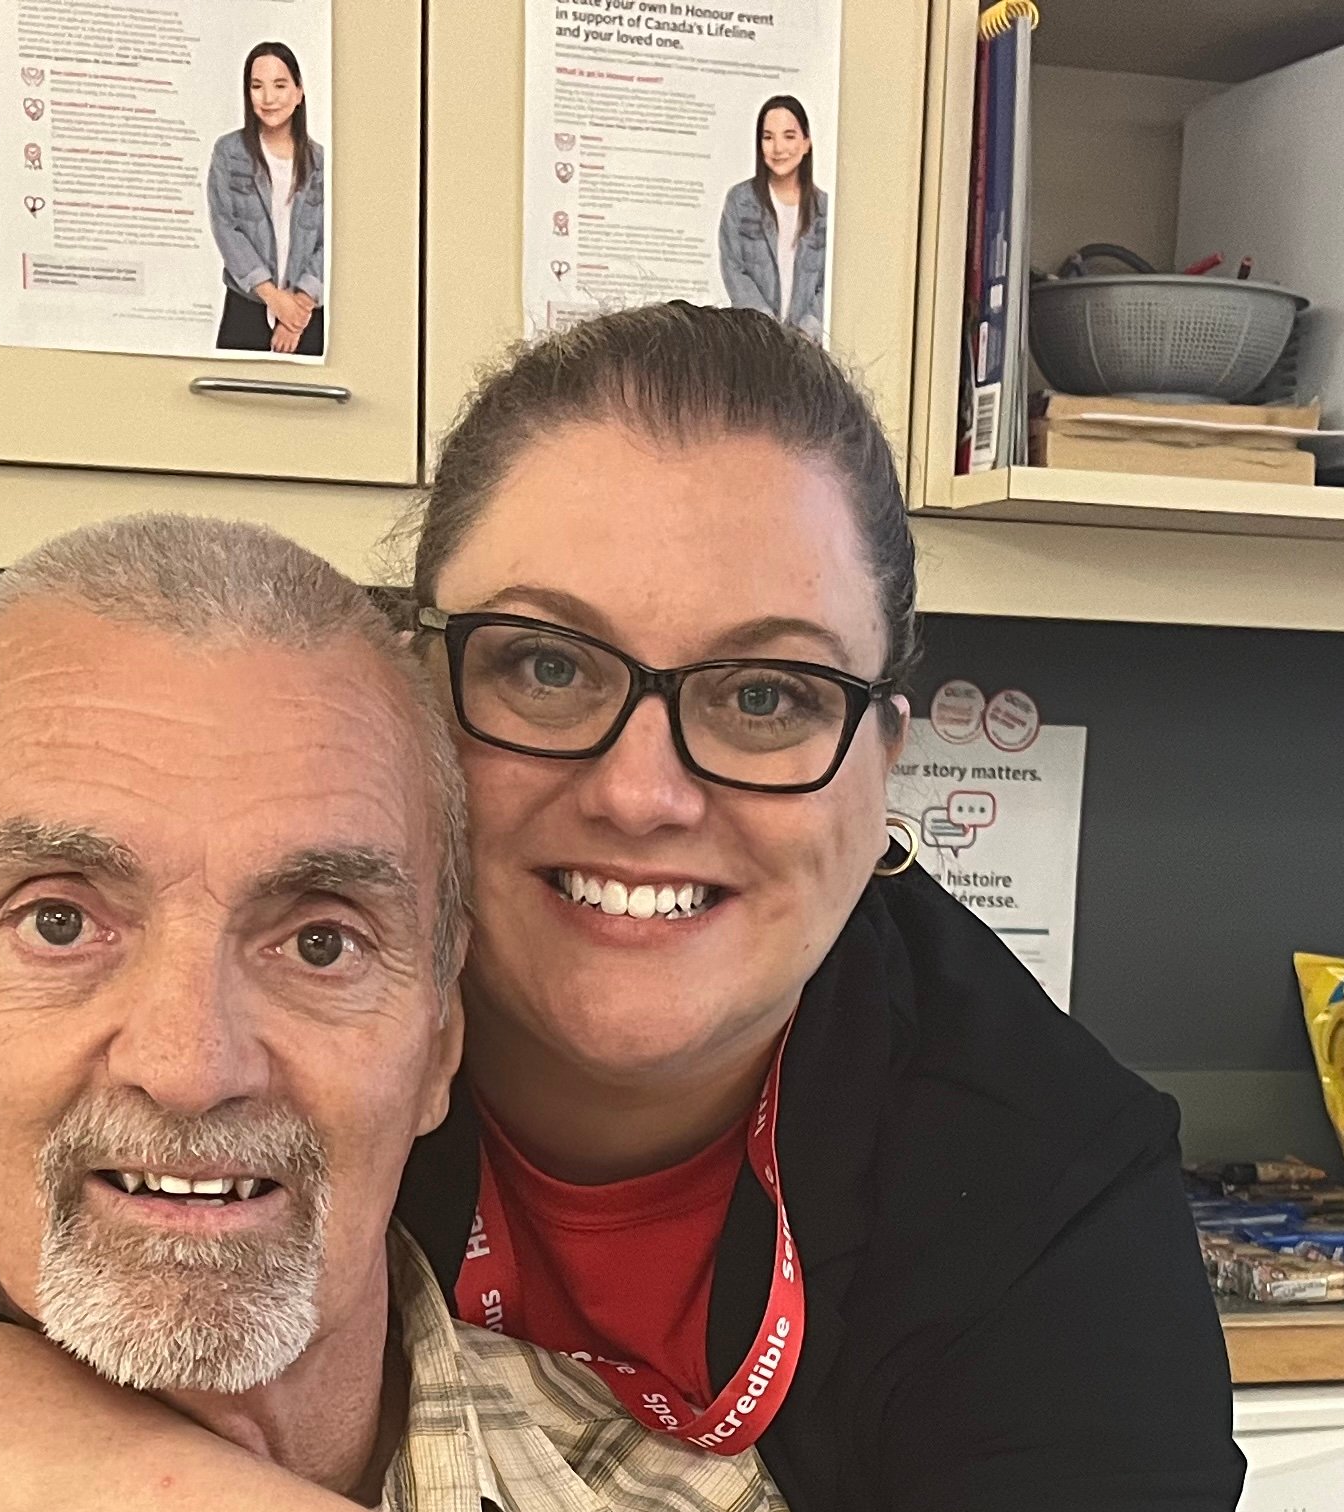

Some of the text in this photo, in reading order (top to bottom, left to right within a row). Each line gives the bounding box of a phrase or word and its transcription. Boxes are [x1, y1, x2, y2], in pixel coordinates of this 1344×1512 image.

[555, 7, 755, 40] in support of Canada's Lifeline
[639, 3, 666, 13] own
[686, 4, 733, 21] Honour
[737, 13, 774, 26] event
[555, 25, 683, 49] and your loved one.
[890, 763, 1042, 782] our story matters.
[947, 870, 1012, 888] histoire
[954, 891, 1018, 908] éresse.
[687, 1316, 790, 1449] Incredible
